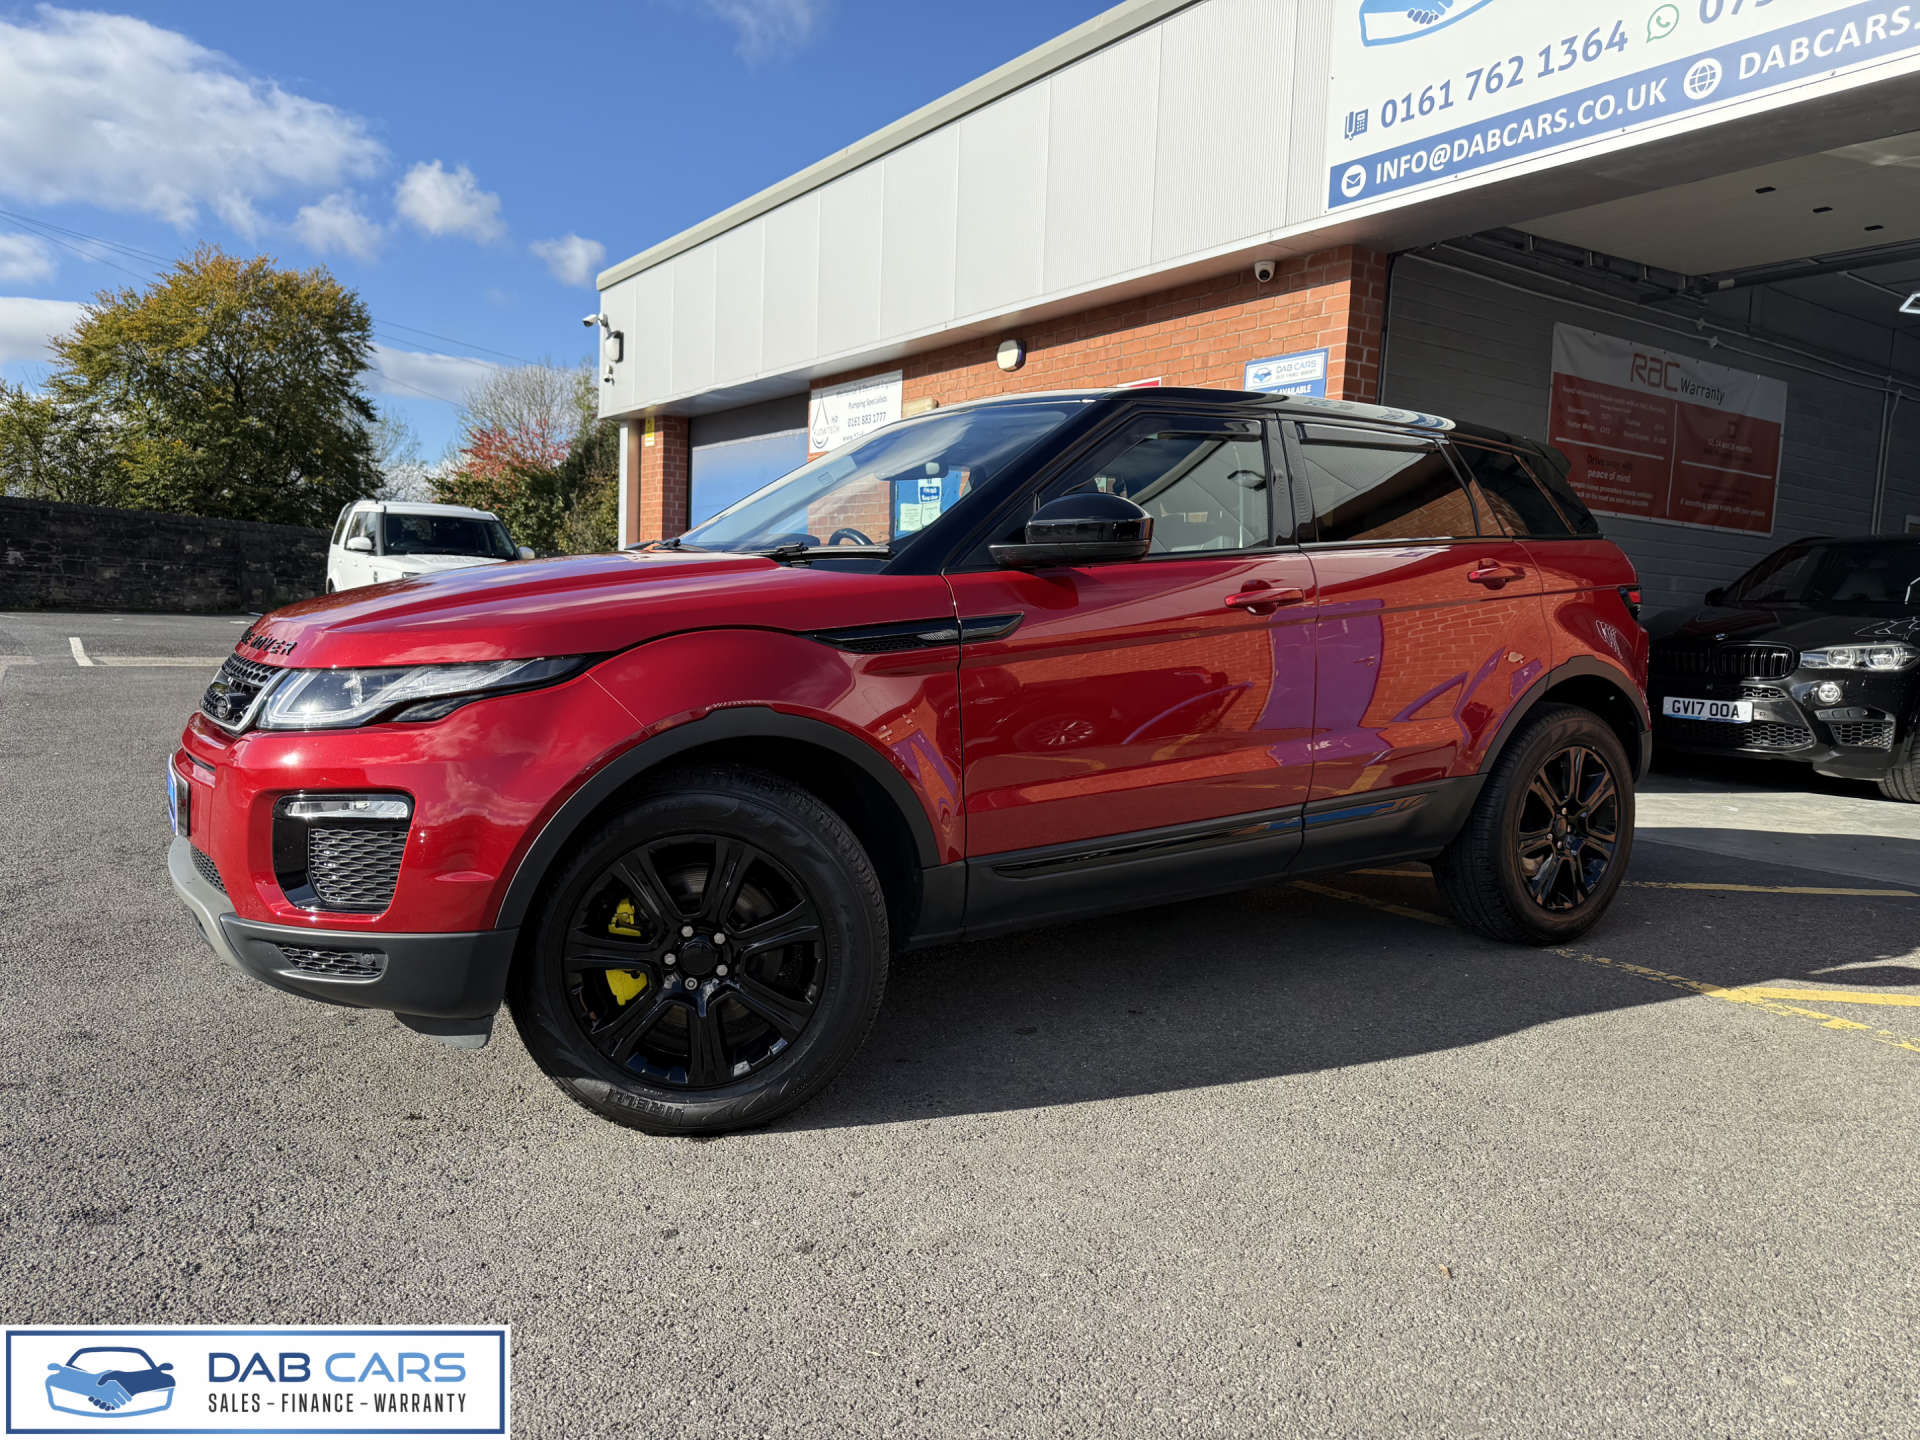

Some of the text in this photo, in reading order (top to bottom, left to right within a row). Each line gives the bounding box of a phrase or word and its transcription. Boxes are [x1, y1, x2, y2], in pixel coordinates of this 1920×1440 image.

[1380, 79, 1454, 128] 0161
[1465, 55, 1524, 101] 762
[1537, 20, 1628, 78] 1364
[1376, 77, 1668, 185] INFO@DABCARS.CO.UK
[1630, 352, 1681, 392] RAC
[1680, 376, 1726, 405] Warranty
[1672, 699, 1705, 715] GV17
